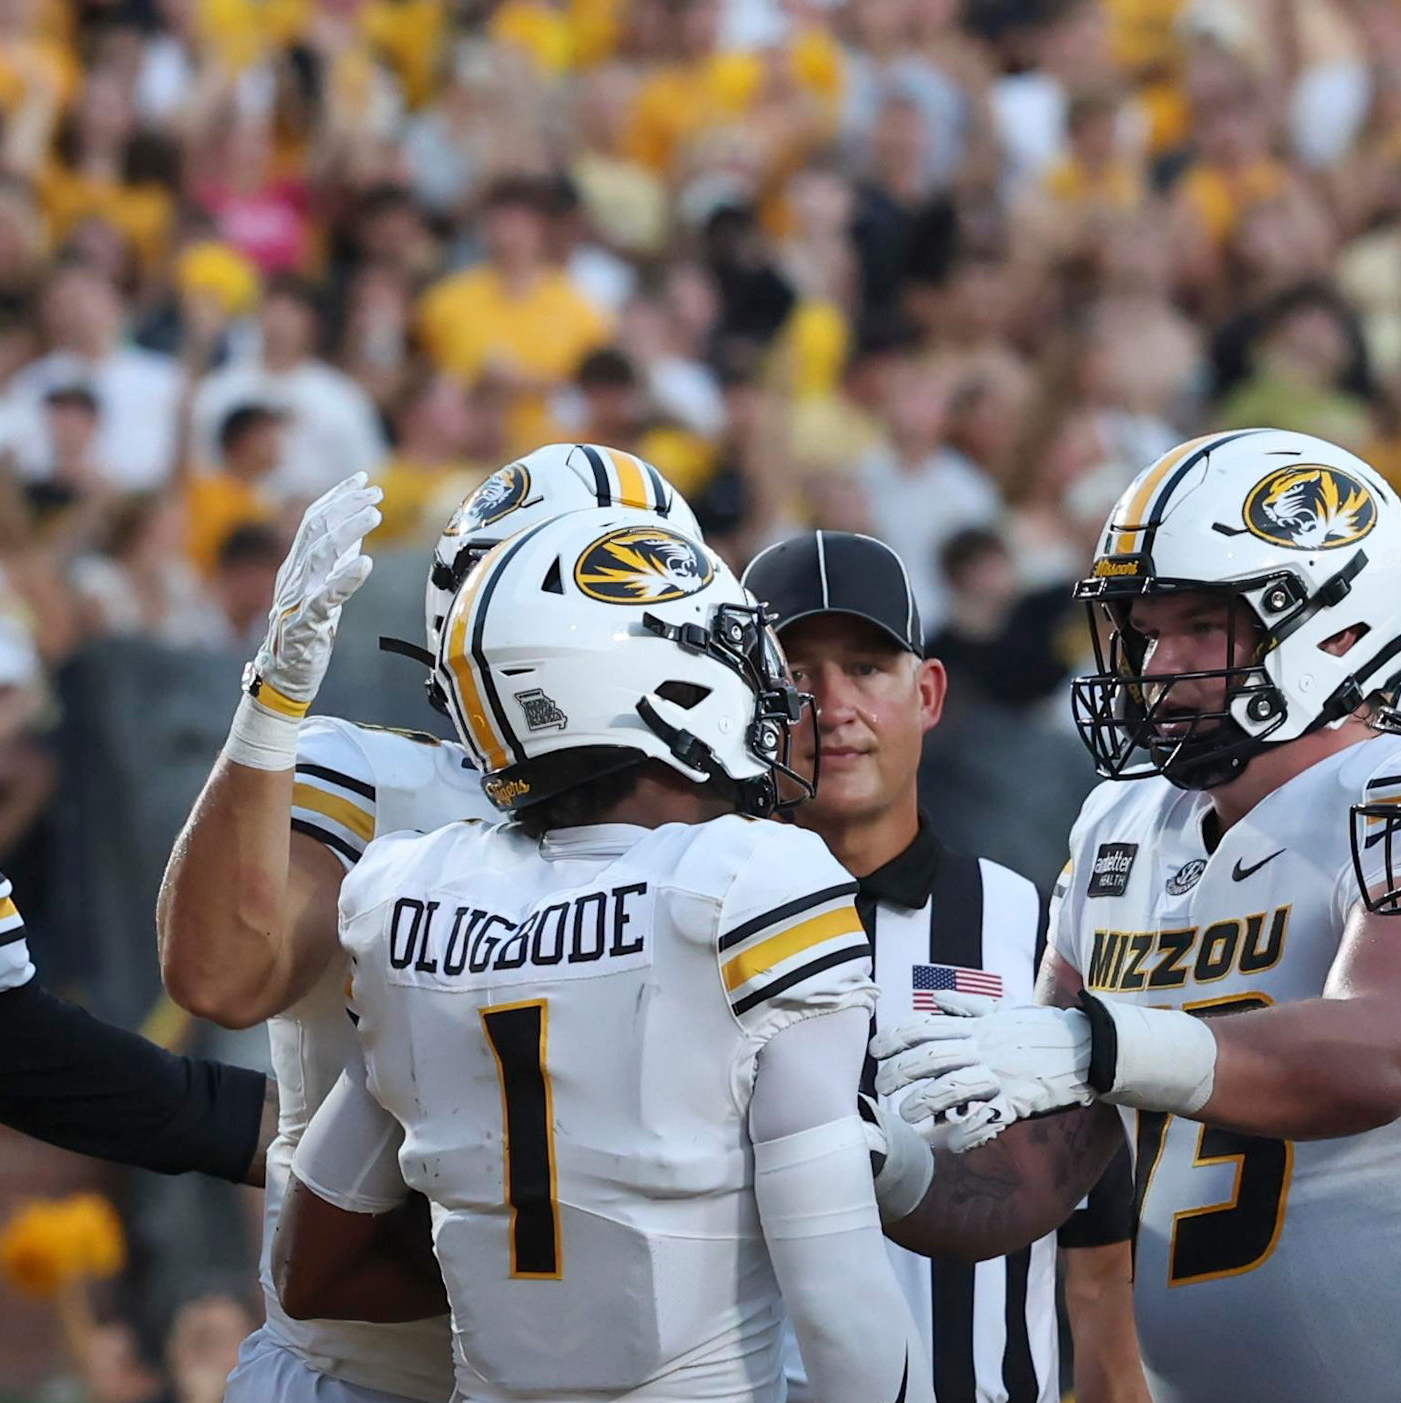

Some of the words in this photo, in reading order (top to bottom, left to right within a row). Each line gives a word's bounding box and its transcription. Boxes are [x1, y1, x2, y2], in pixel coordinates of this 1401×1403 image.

[389, 881, 648, 977] OLUGBODE
[1087, 903, 1294, 993] MIZZOU
[478, 998, 563, 1280] 1
